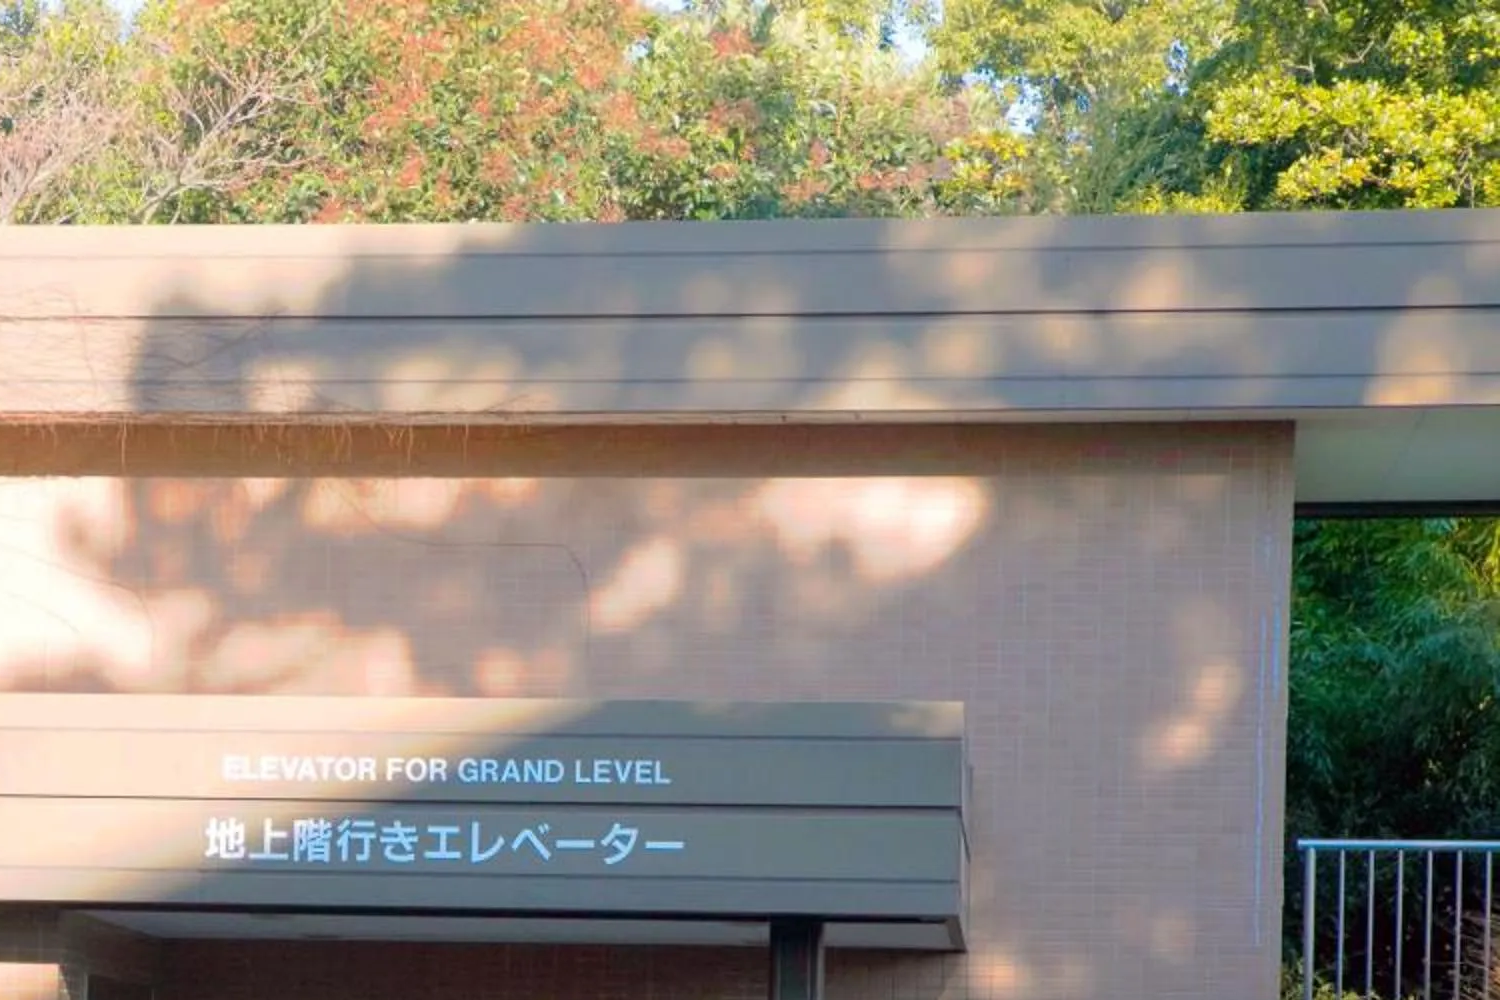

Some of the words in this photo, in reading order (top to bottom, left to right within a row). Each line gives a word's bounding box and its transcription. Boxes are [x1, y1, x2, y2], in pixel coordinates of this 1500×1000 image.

[222, 755, 377, 781] ELEVATOR
[386, 757, 448, 782] FOR
[457, 758, 565, 783] GRAND
[575, 759, 672, 784] LEVEL
[204, 816, 685, 865] 地上階行きエレベーター
